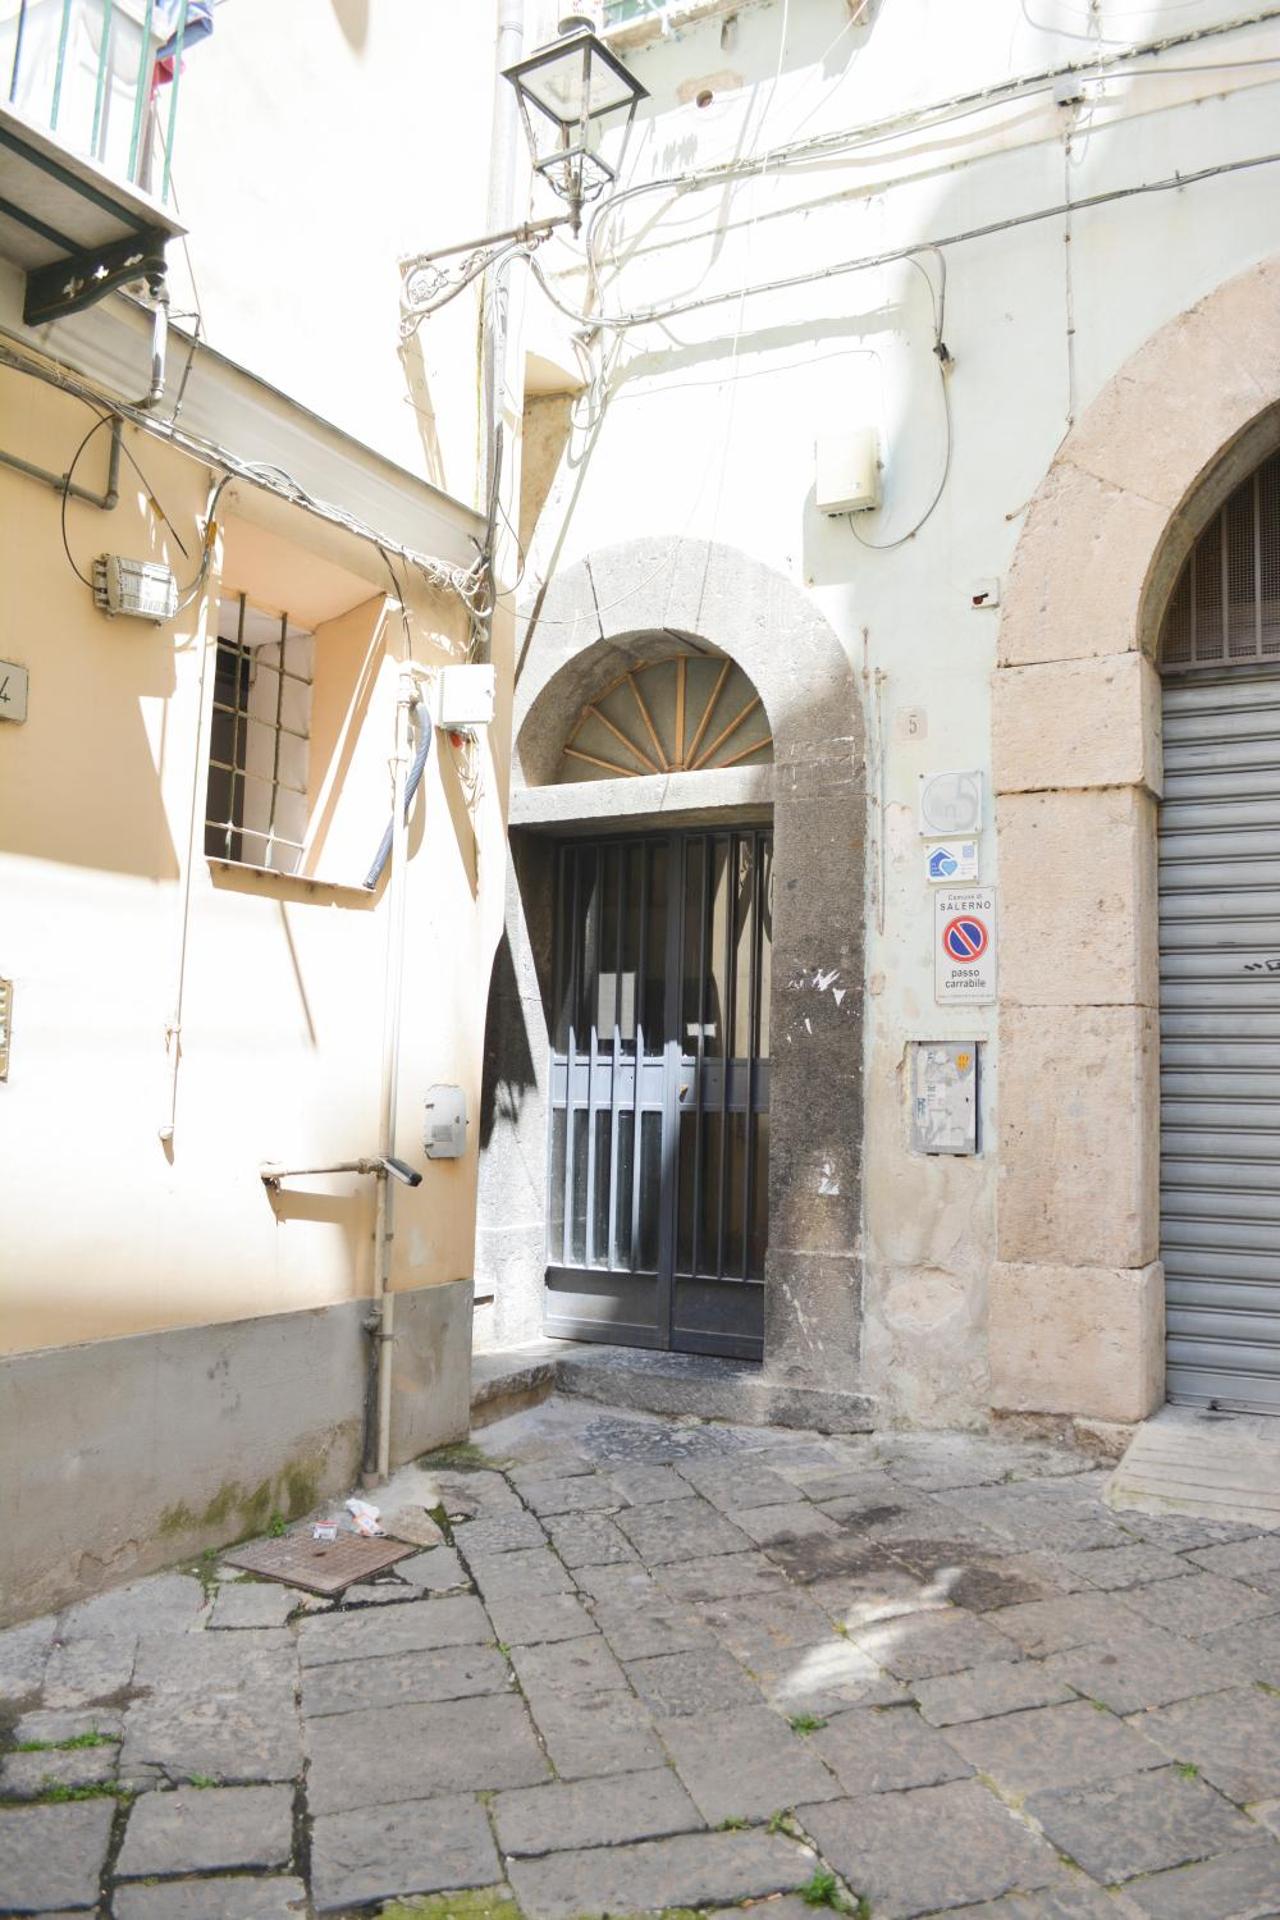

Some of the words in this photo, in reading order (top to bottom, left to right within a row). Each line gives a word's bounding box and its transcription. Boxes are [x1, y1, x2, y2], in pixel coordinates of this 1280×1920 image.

[908, 713, 918, 735] 5
[940, 901, 991, 911] SALERNO
[951, 969, 980, 979] passo
[945, 979, 986, 988] carrabile
